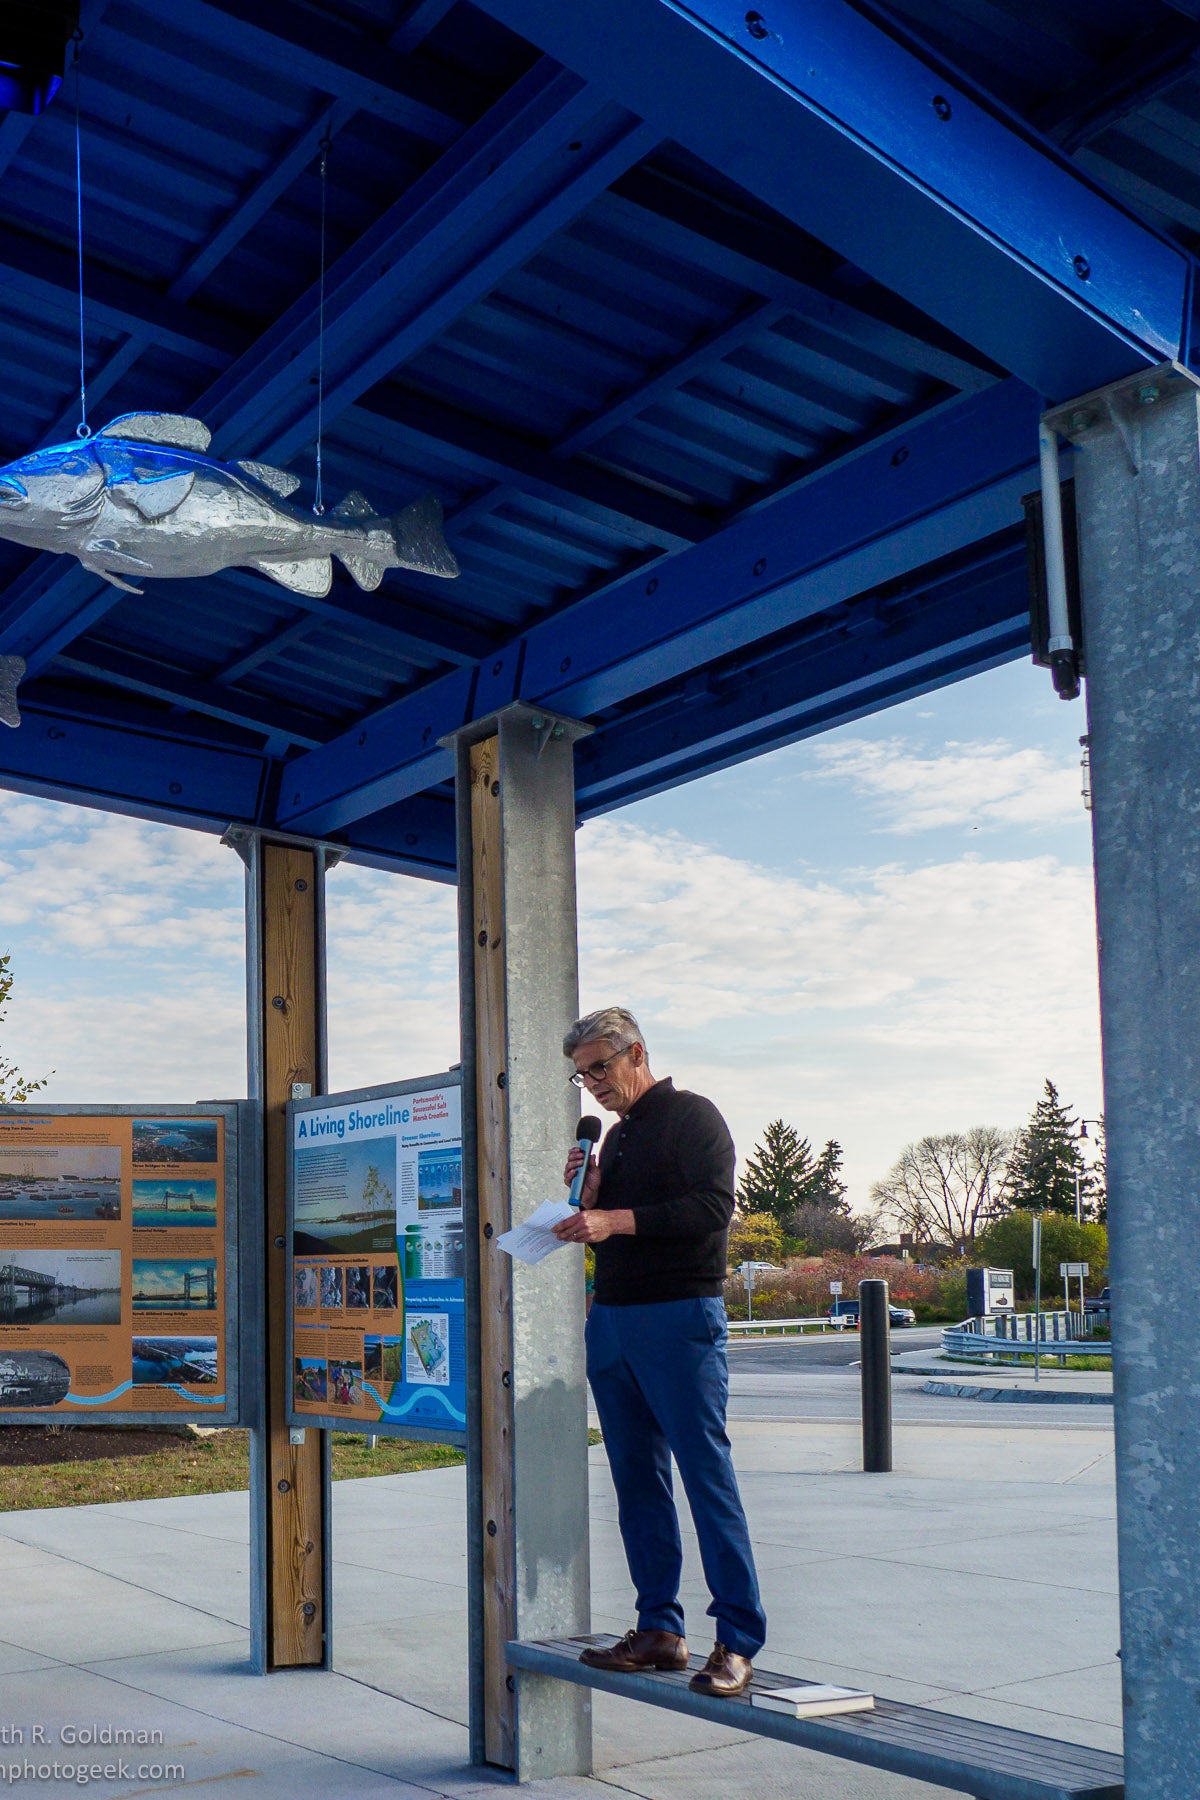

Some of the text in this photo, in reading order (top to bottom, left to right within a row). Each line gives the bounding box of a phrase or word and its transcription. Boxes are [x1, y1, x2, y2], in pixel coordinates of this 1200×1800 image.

[298, 1105, 410, 1138] A Living Shoreline
